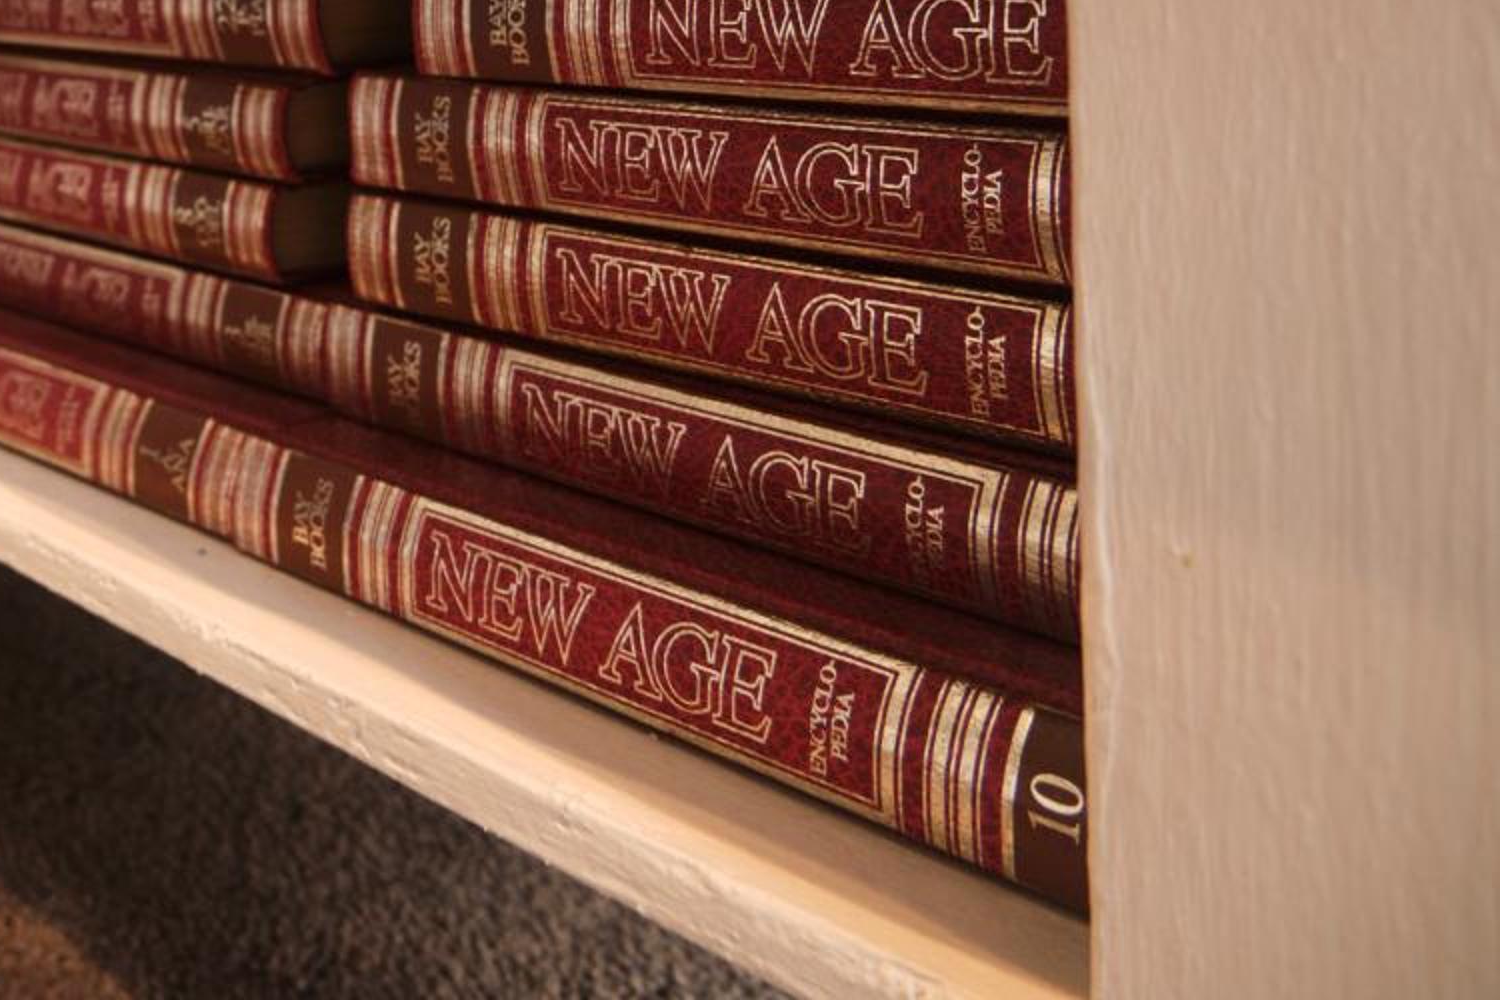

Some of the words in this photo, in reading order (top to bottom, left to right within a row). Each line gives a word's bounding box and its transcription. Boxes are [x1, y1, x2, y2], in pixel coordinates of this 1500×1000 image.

[414, 111, 434, 165] BAY
[431, 95, 455, 184] BOOKS
[554, 116, 730, 211] NEW
[742, 134, 925, 238] AGE
[983, 168, 1005, 235] PEDIA
[414, 230, 433, 285] BAY
[431, 215, 453, 305] BOOKS
[555, 247, 732, 354] NEW
[745, 280, 929, 397] AGE
[386, 353, 404, 405] AY
[521, 383, 688, 493] NEW
[699, 433, 872, 550] AGE
[292, 490, 311, 546] BAY
[308, 478, 335, 571] BOOKS
[425, 529, 597, 667] NEW
[599, 601, 778, 745] AGE
[808, 659, 838, 777] ENCYCLO-
[830, 692, 856, 764] PEDIA
[1026, 772, 1085, 847] 10
